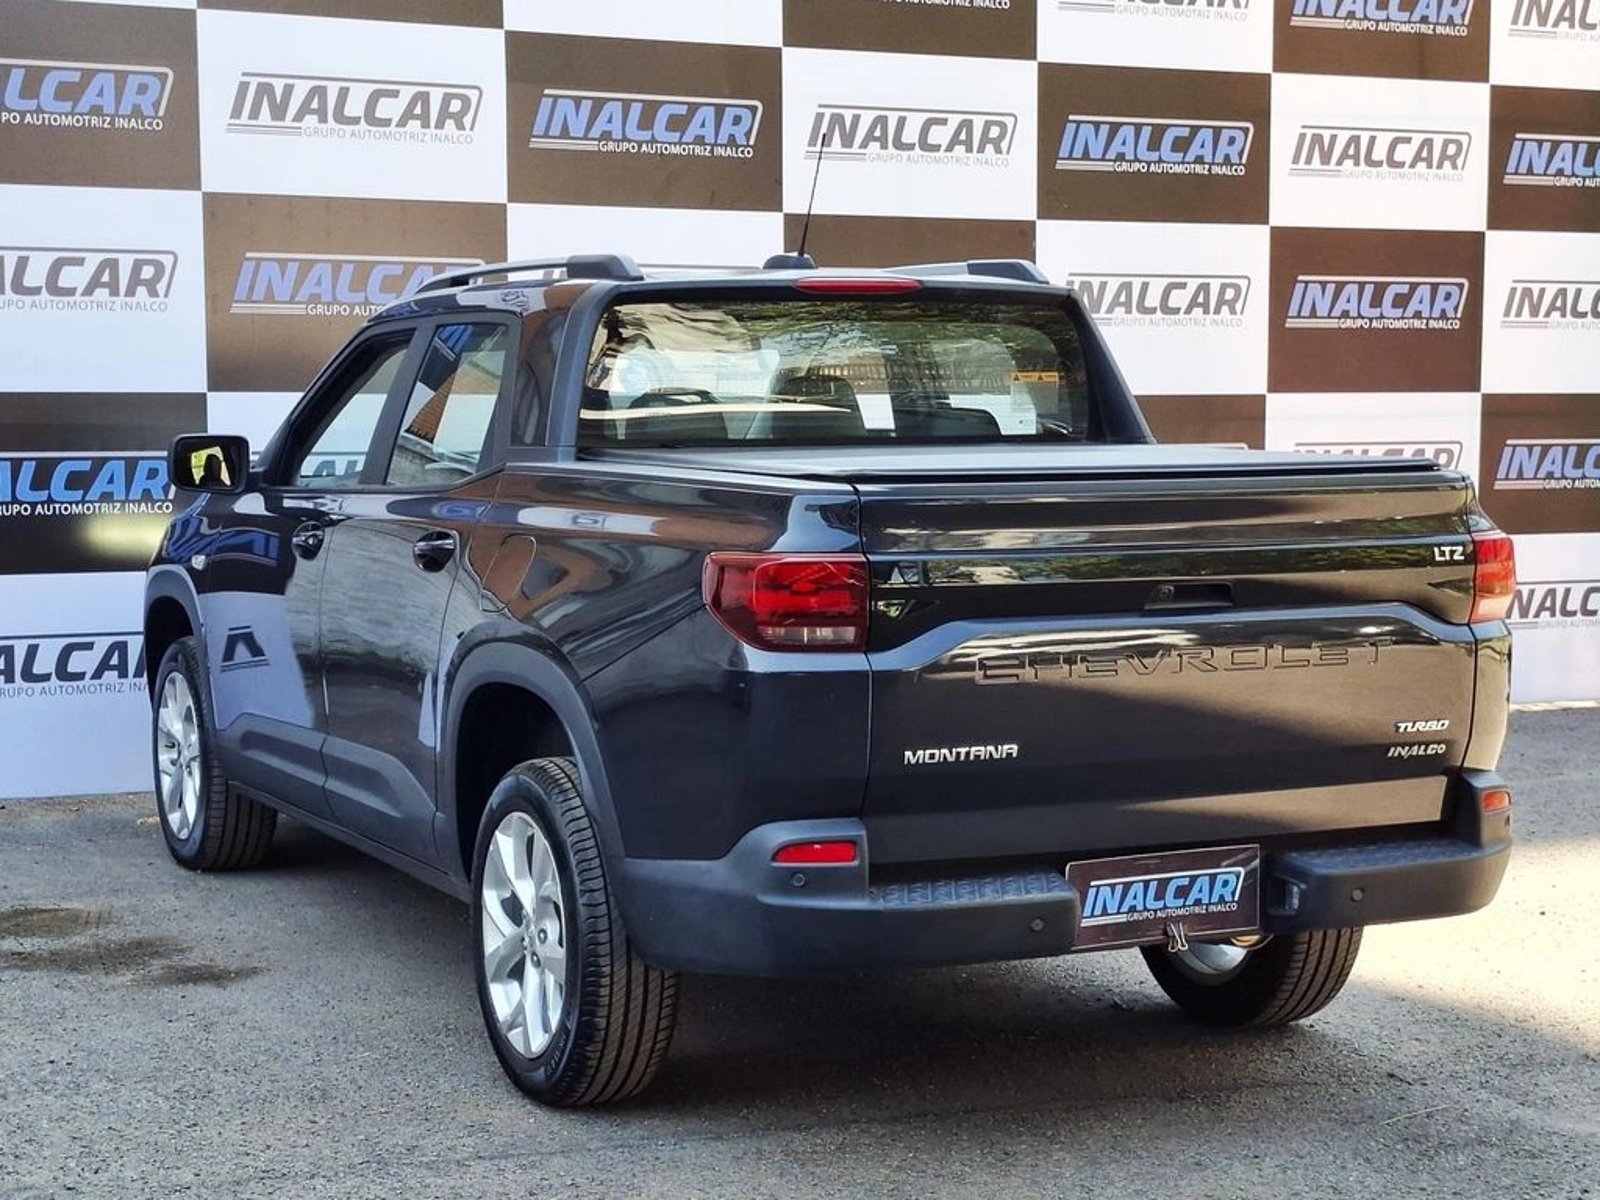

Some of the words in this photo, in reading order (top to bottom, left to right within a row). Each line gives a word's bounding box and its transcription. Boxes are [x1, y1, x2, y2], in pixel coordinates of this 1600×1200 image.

[1511, 0, 1600, 30] INAL
[1344, 20, 1376, 31] GRUPO
[1377, 22, 1434, 35] AUTOMOTRIZ
[1436, 25, 1468, 37] INALCO
[229, 80, 472, 131] INALCAR
[24, 113, 111, 128] AUTOMOTRIZ
[115, 119, 163, 131] INALCO
[532, 97, 753, 145] INALCAR
[303, 126, 346, 138] GRUPO
[349, 128, 428, 143] AUTOMOTRIZ
[430, 133, 473, 145] INALCO
[807, 112, 1009, 155] INALCAR
[1058, 122, 1246, 163] INALCAR
[599, 140, 638, 152] GRUPO
[640, 143, 712, 156] AUTOMOTRIZ
[713, 146, 754, 158] INALCO
[1291, 132, 1464, 170] INALCAR
[1506, 140, 1600, 177] INAL
[868, 153, 903, 164] GRUPO
[906, 154, 971, 166] AUTOMOTRIZ
[973, 157, 1010, 167] INALCO
[1114, 162, 1148, 173] GRUPO
[1149, 163, 1209, 175] AUTOMOTRIZ
[1211, 164, 1246, 176] INALCO
[1554, 177, 1583, 187] GRUPO
[0, 255, 166, 298] LCAR
[233, 260, 475, 303] INALCA
[30, 299, 117, 312] AUTOMOTRIZ
[120, 301, 168, 313] INALCO
[1066, 280, 1243, 315] NALCAR
[1287, 282, 1460, 318] INALCAR
[307, 303, 350, 316] GRUPO
[1113, 316, 1145, 327] GRUPO
[1148, 316, 1208, 328] AUTOMOTRIZ
[1338, 318, 1370, 329] GRUPO
[1371, 318, 1427, 329] AUTOMOTRIZ
[1428, 319, 1460, 329] INALCO
[1544, 479, 1573, 489] GRUPO
[35, 503, 121, 515] AUTOMOTRIZ
[125, 502, 173, 514] INALCO
[1433, 546, 1464, 561] LTZ
[1505, 587, 1600, 619] NALC
[0, 640, 146, 684] ALCA
[976, 636, 1397, 685] CHEVROLET
[39, 682, 125, 697] AUTOMOTRIZ
[1396, 720, 1450, 733] TURBO
[904, 744, 1018, 765] MONTANA
[1387, 743, 1447, 760] INALCO
[1083, 873, 1238, 917] INALCAR
[1127, 912, 1155, 922] GRUPO
[1156, 905, 1207, 918] AUTOMOTRIZ
[1208, 902, 1238, 914] INALCO
